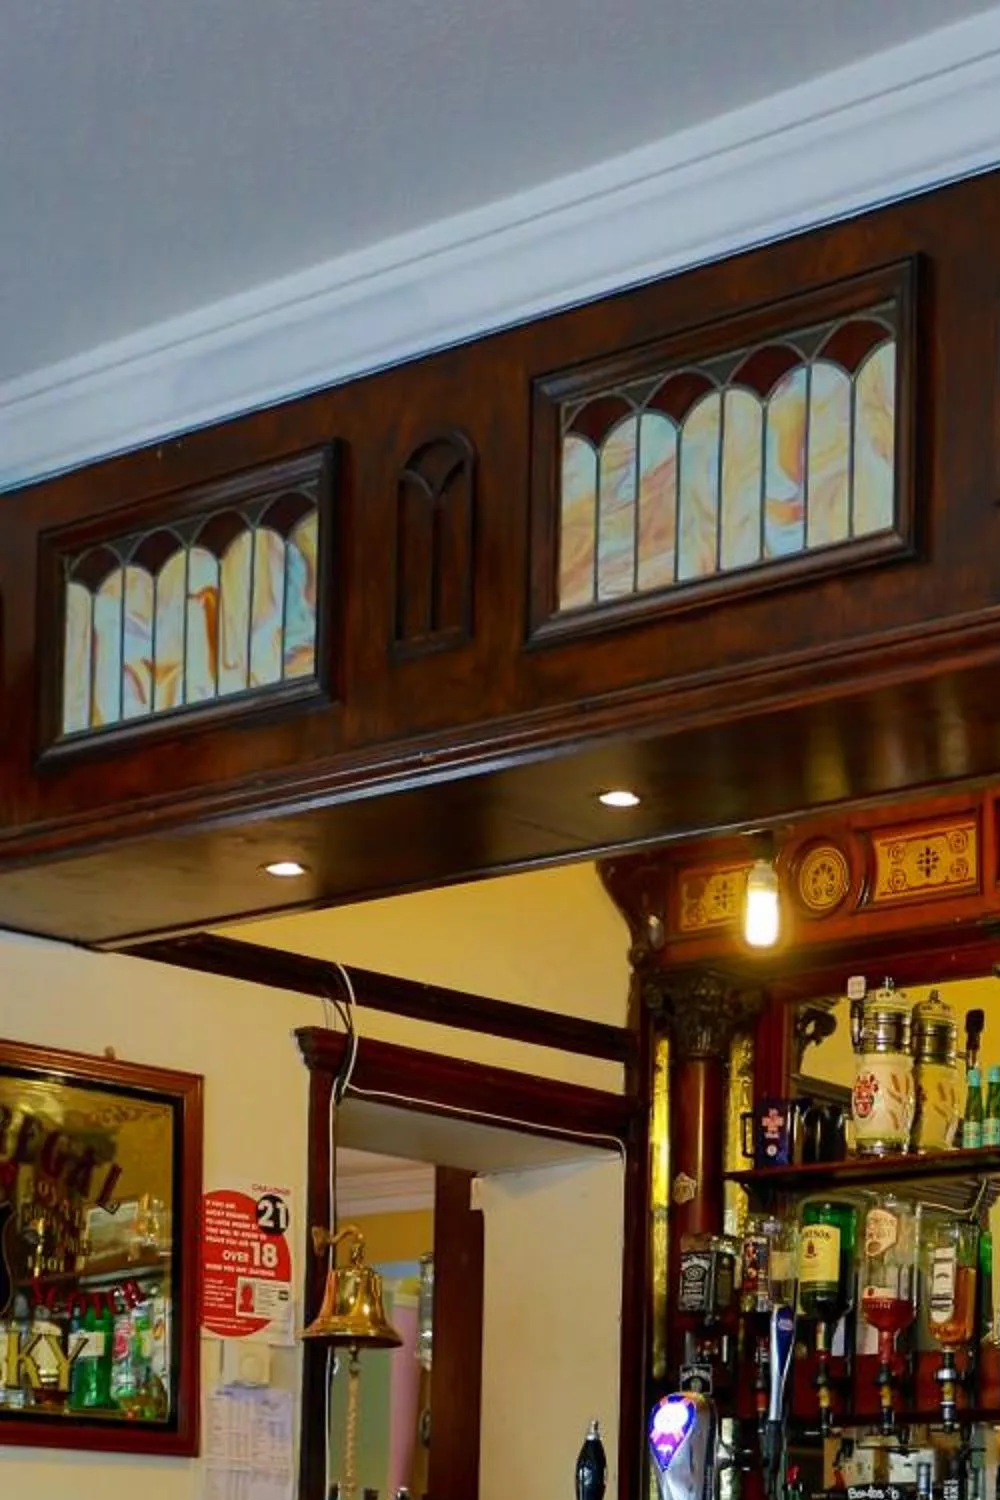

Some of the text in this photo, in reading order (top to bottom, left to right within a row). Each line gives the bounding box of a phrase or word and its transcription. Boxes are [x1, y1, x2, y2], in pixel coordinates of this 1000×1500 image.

[257, 1199, 288, 1229] 21
[222, 1241, 279, 1269] OVER 18
